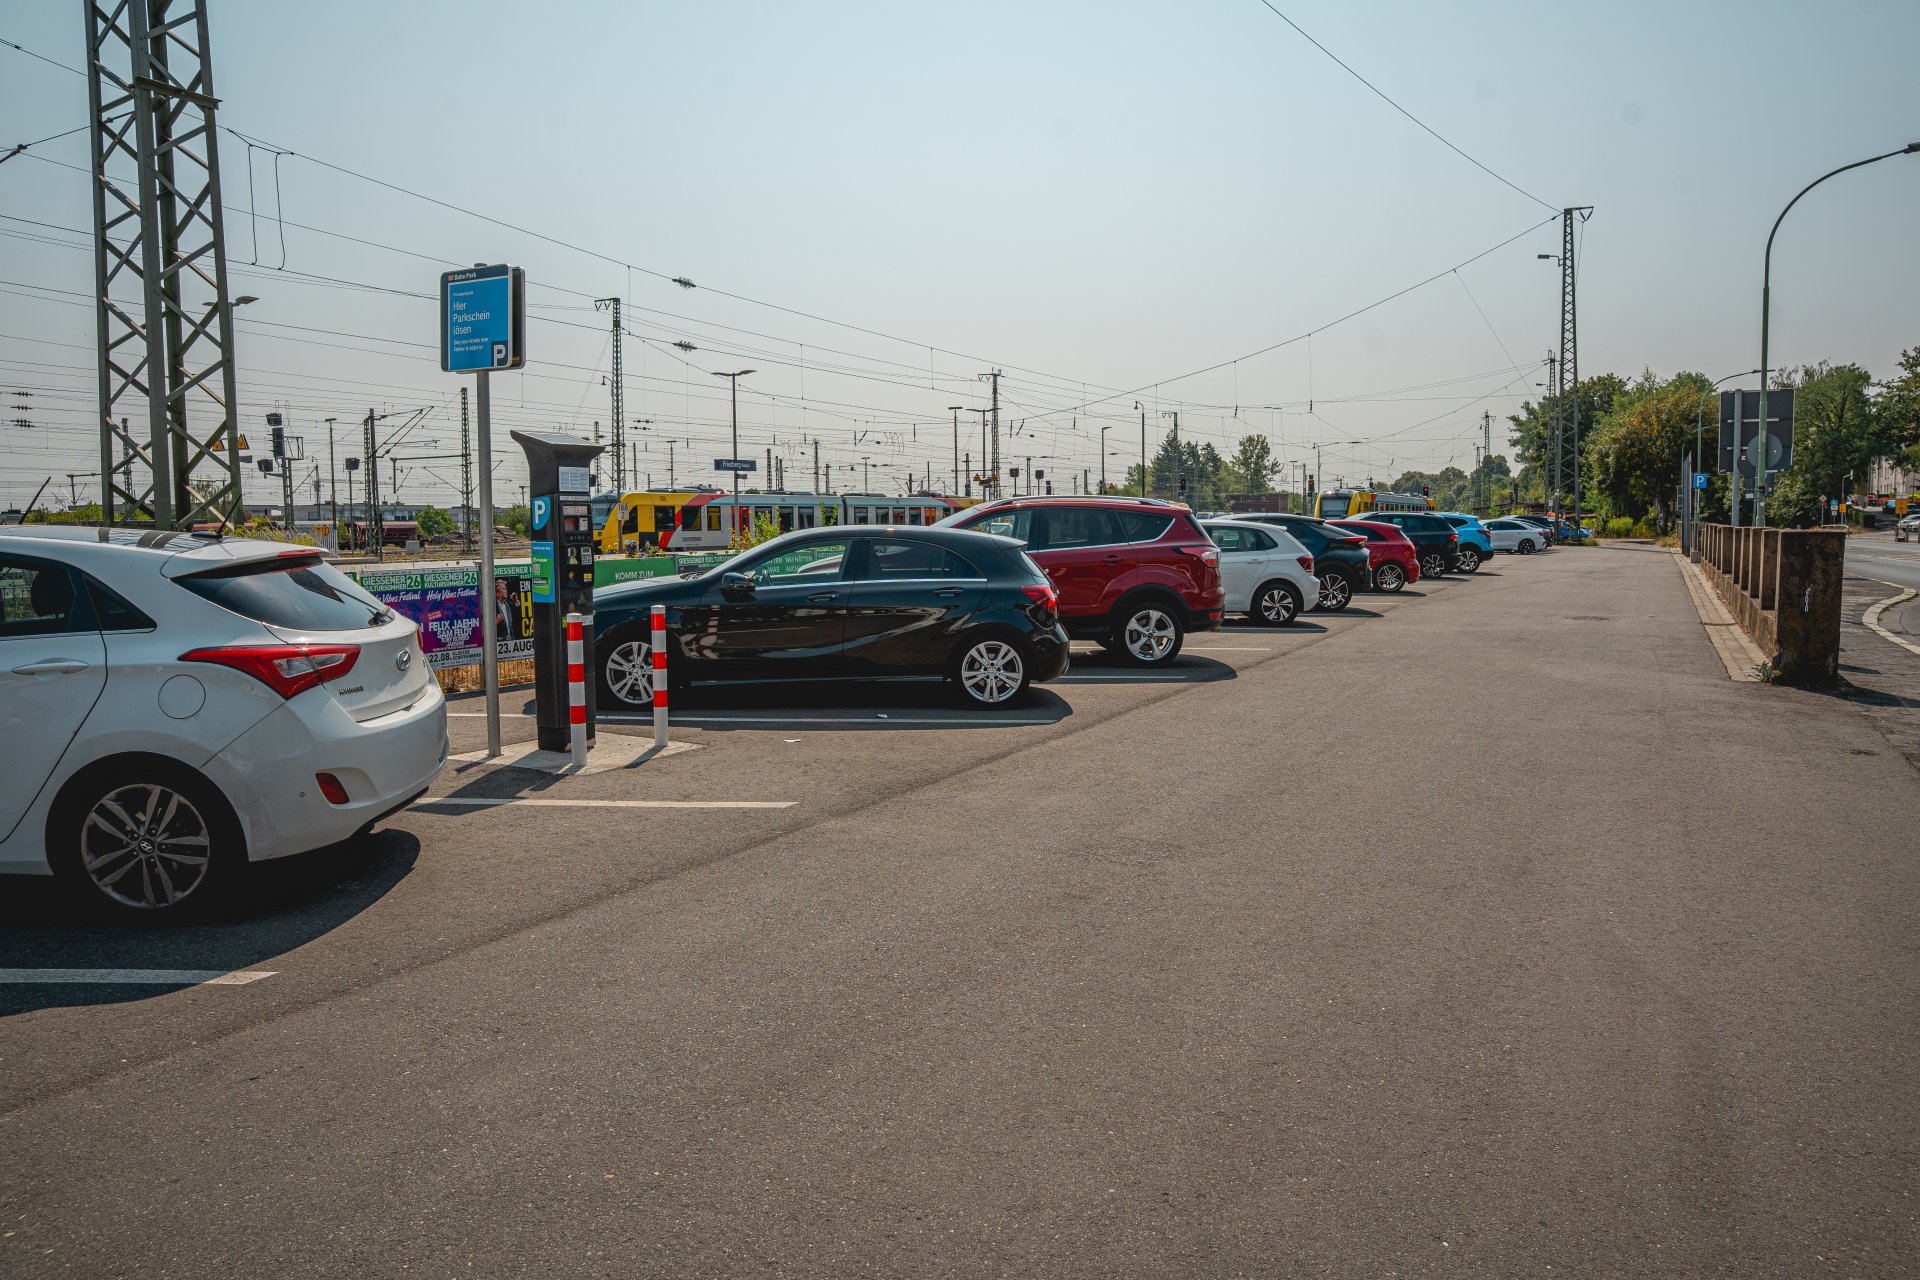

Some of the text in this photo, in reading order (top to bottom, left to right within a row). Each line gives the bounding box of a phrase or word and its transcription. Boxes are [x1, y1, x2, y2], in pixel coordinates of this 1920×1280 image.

[453, 301, 467, 311] Hier
[453, 310, 490, 323] Parkschein
[453, 325, 472, 335] lösen
[494, 345, 506, 367] P
[1696, 475, 1704, 487] P
[534, 500, 546, 524] P
[678, 557, 705, 565] GIESSENER
[493, 566, 529, 576] GIESSENER
[615, 570, 654, 581] KOMM ZUM
[363, 575, 406, 586] GIESSENER
[406, 575, 421, 588] 26
[423, 572, 464, 582] GIESSENER
[464, 572, 477, 585] 26
[424, 580, 465, 588] KULTURSOMMER
[520, 580, 531, 592] EIN
[399, 590, 422, 602] Festival
[427, 590, 441, 601] Holy
[457, 587, 478, 598] Festival
[428, 620, 450, 632] FELIX
[451, 618, 480, 630] JAEHN
[437, 627, 473, 639] SAM FELDT
[497, 643, 511, 655] 23.
[429, 652, 453, 663] 22.08.
